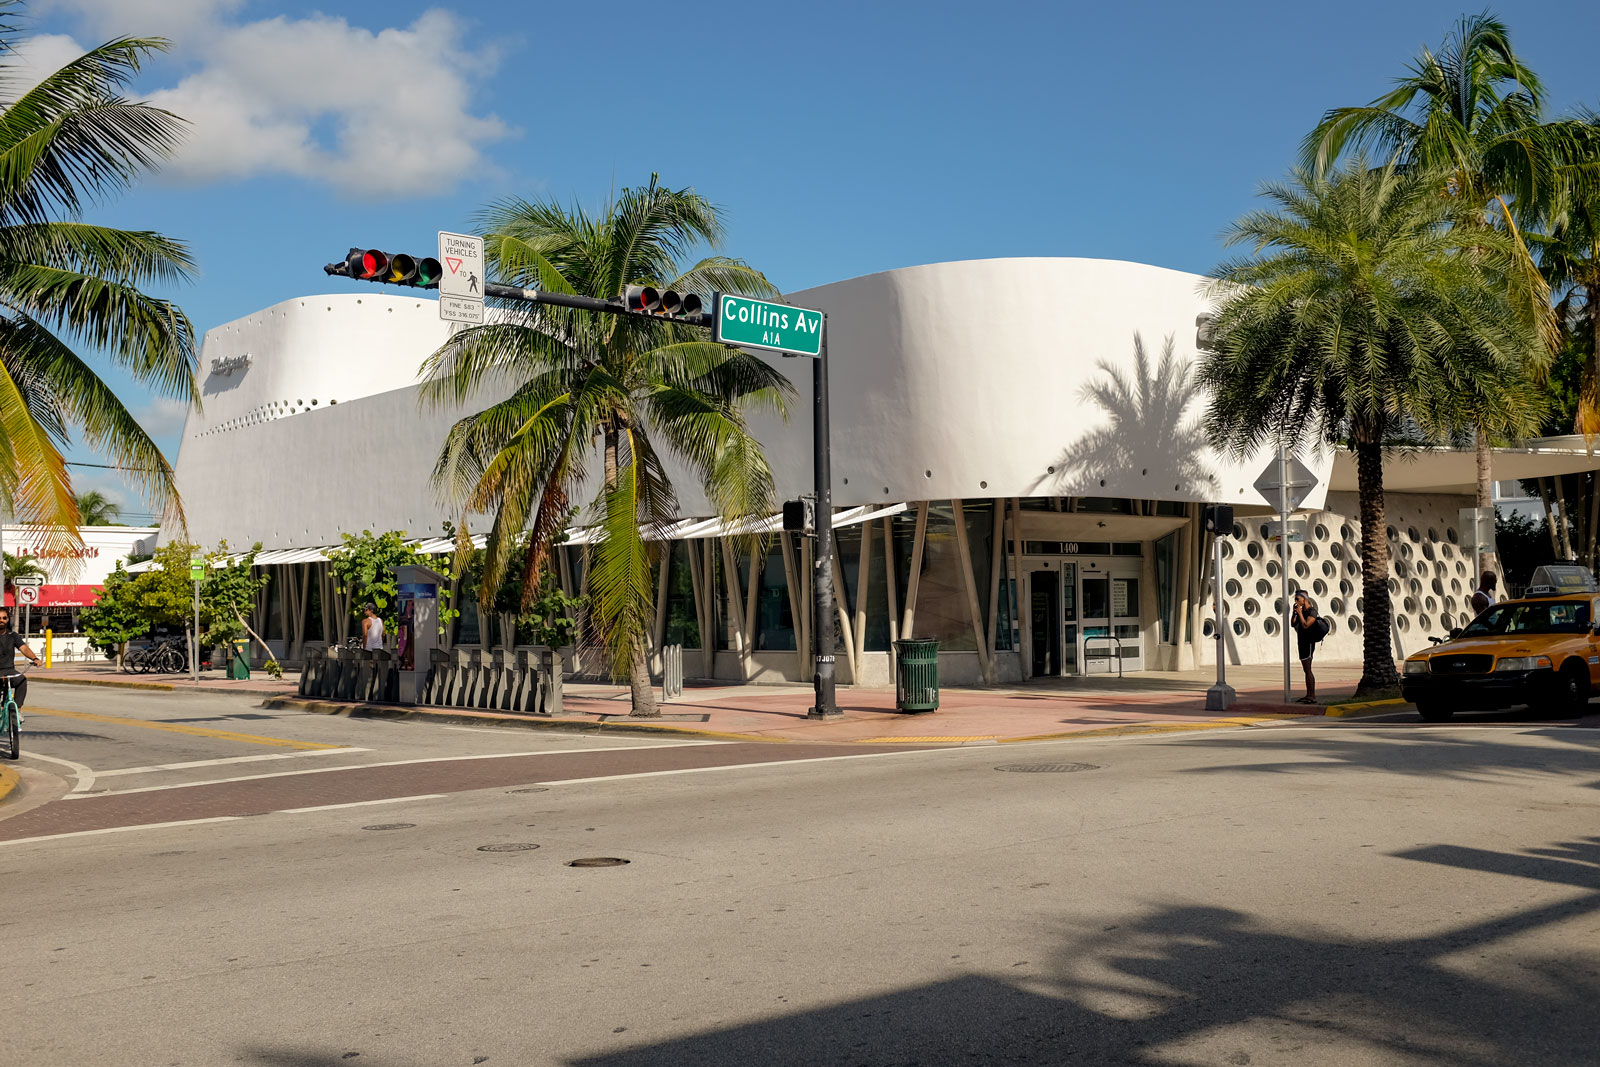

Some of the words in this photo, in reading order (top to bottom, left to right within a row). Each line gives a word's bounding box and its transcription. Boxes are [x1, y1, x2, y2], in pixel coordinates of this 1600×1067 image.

[447, 238, 476, 250] TURNING
[445, 247, 478, 258] VEHICLES
[459, 270, 467, 278] TO
[464, 303, 475, 311] $83
[725, 299, 788, 330] Collins
[794, 312, 819, 334] Av
[762, 331, 781, 345] A1A
[1059, 542, 1079, 554] 1400
